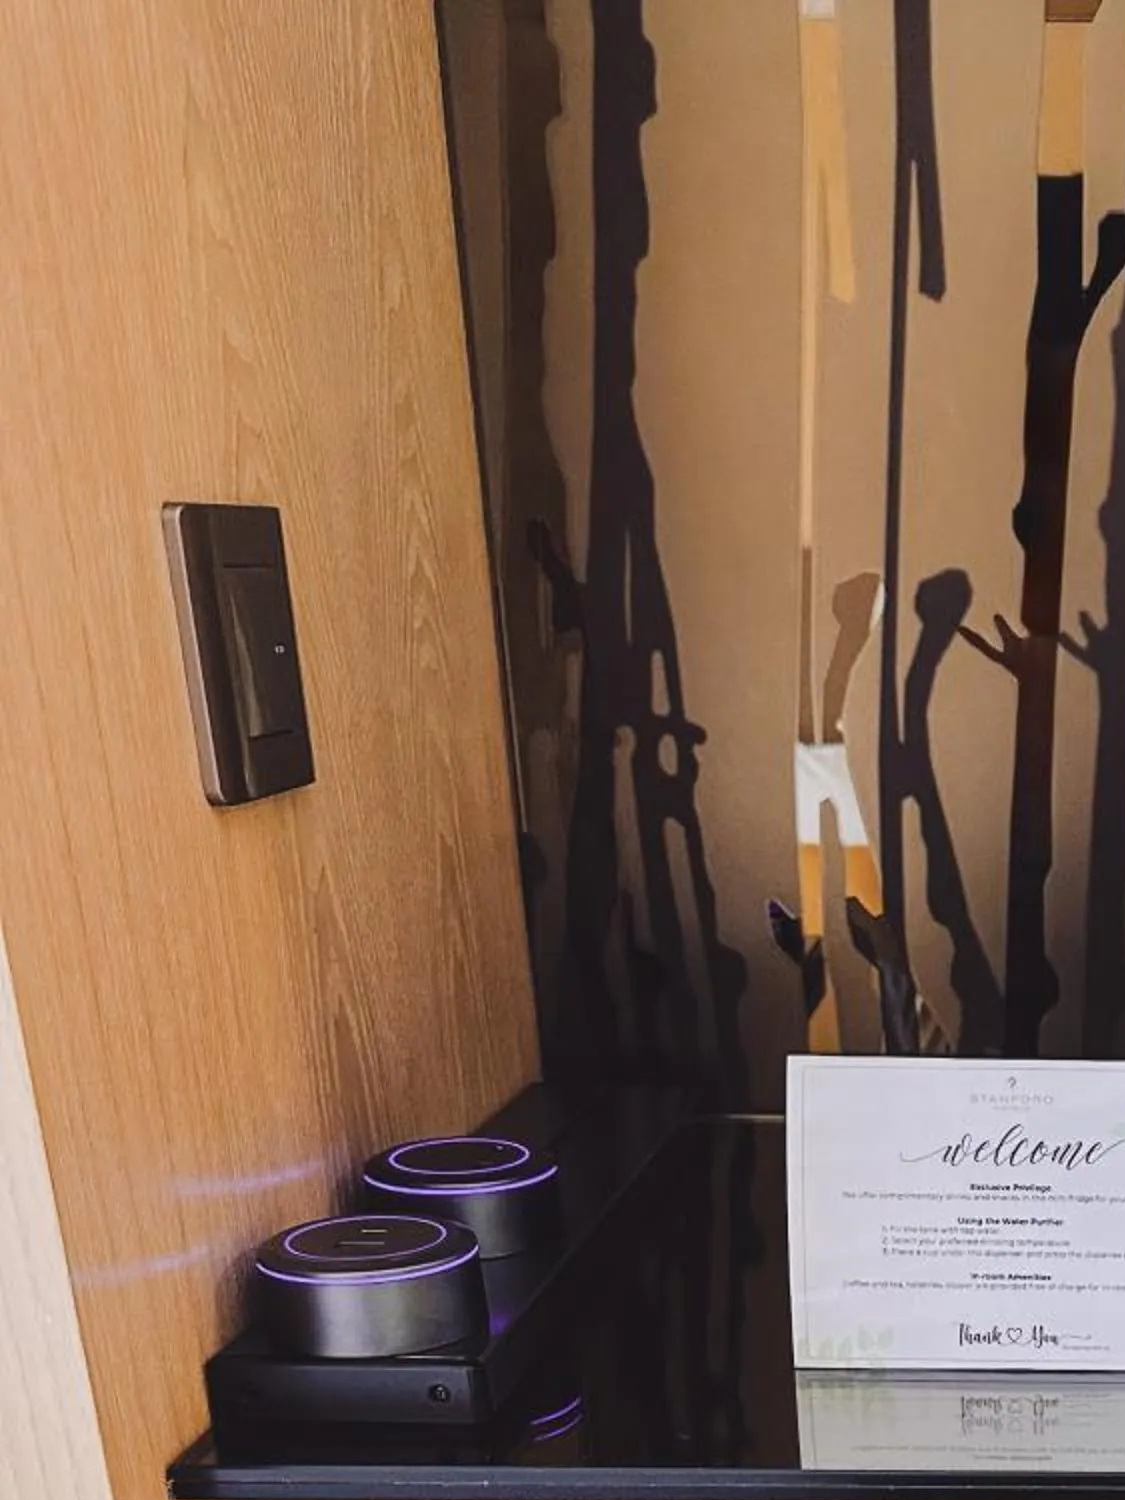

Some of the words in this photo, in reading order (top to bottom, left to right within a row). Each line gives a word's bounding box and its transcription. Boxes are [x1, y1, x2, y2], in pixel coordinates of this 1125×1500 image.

[969, 1183, 1011, 1191] Exclusive
[1013, 1183, 1052, 1193] Privilege
[957, 1217, 983, 1226] Using
[985, 1217, 1001, 1225] the
[1002, 1217, 1029, 1226] Water
[958, 1322, 1003, 1347] Thank
[1032, 1325, 1060, 1349] You
